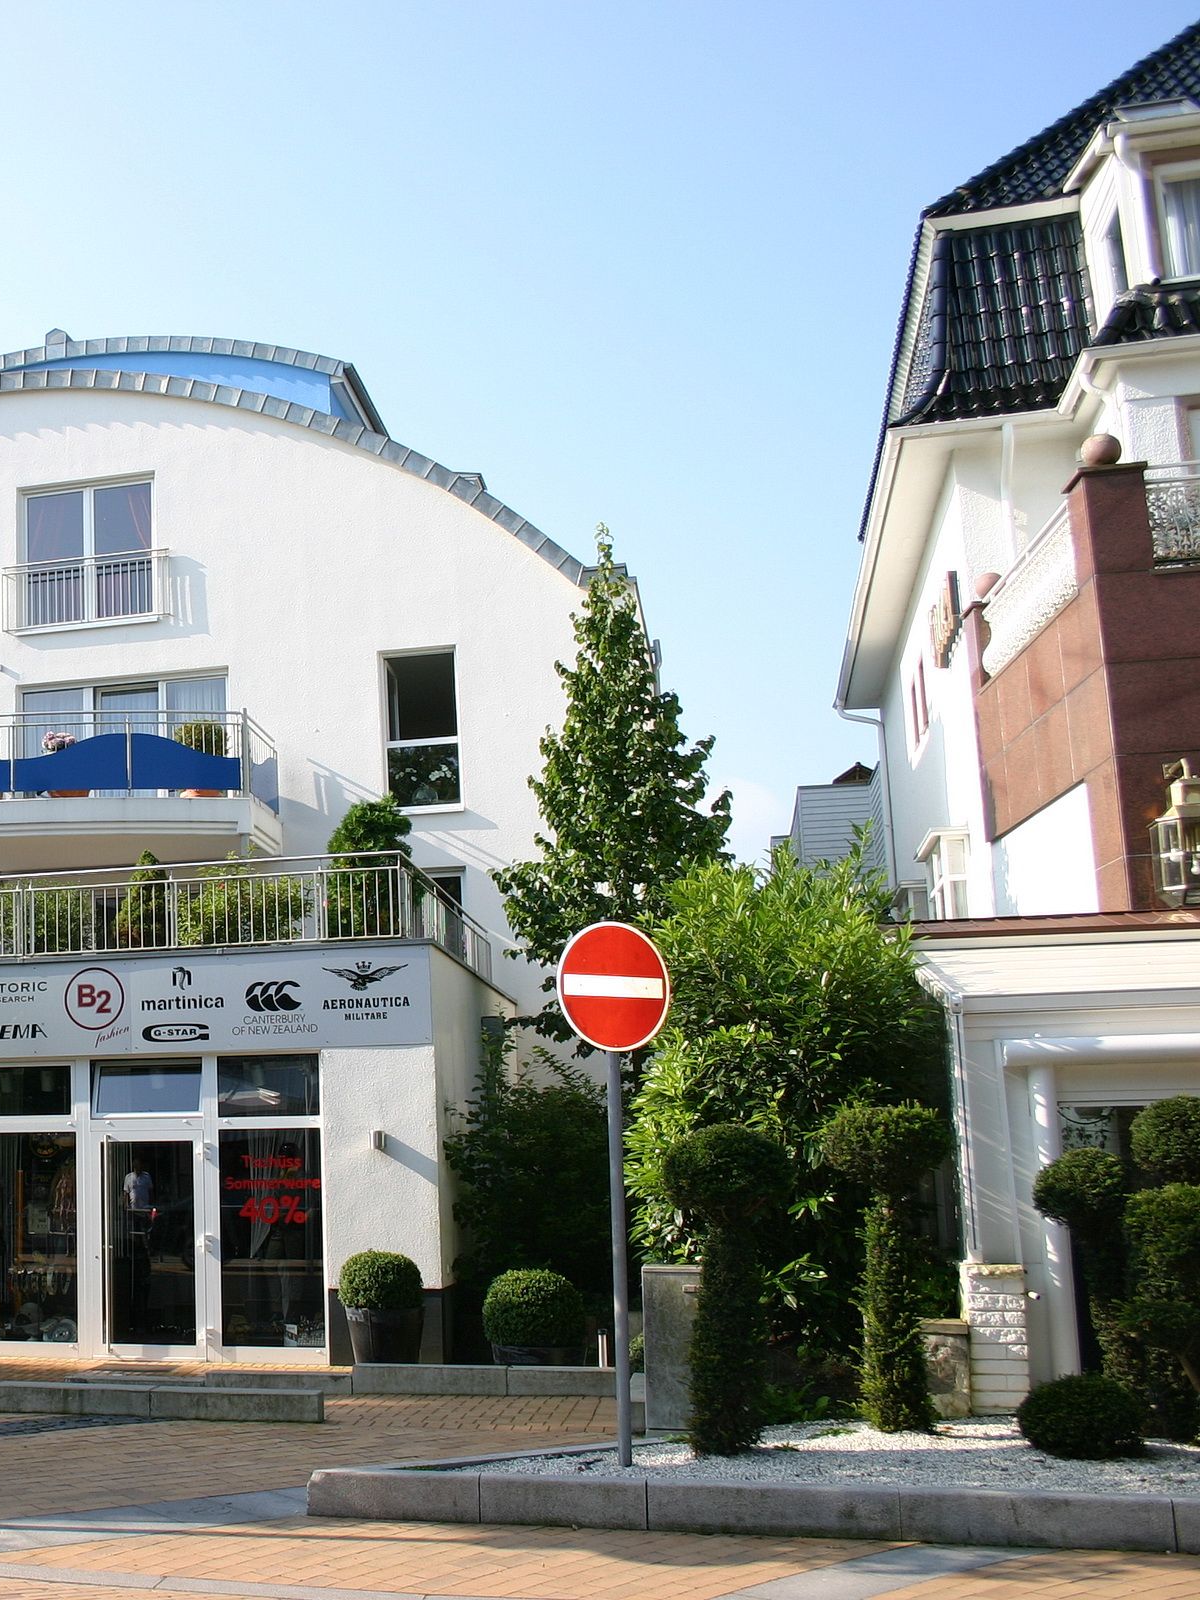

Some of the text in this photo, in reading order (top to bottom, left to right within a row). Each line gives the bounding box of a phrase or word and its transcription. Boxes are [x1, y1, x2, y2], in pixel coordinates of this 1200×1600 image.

[77, 984, 112, 1014] B2
[141, 994, 224, 1012] martinica
[322, 996, 410, 1010] AERONAUTICA
[243, 1014, 306, 1025] CANTERBURY
[344, 1012, 388, 1021] MILITARE
[153, 1027, 197, 1037] G-STAR
[232, 1023, 319, 1035] OF NEW ZEALAND
[239, 1195, 309, 1225] 40%
